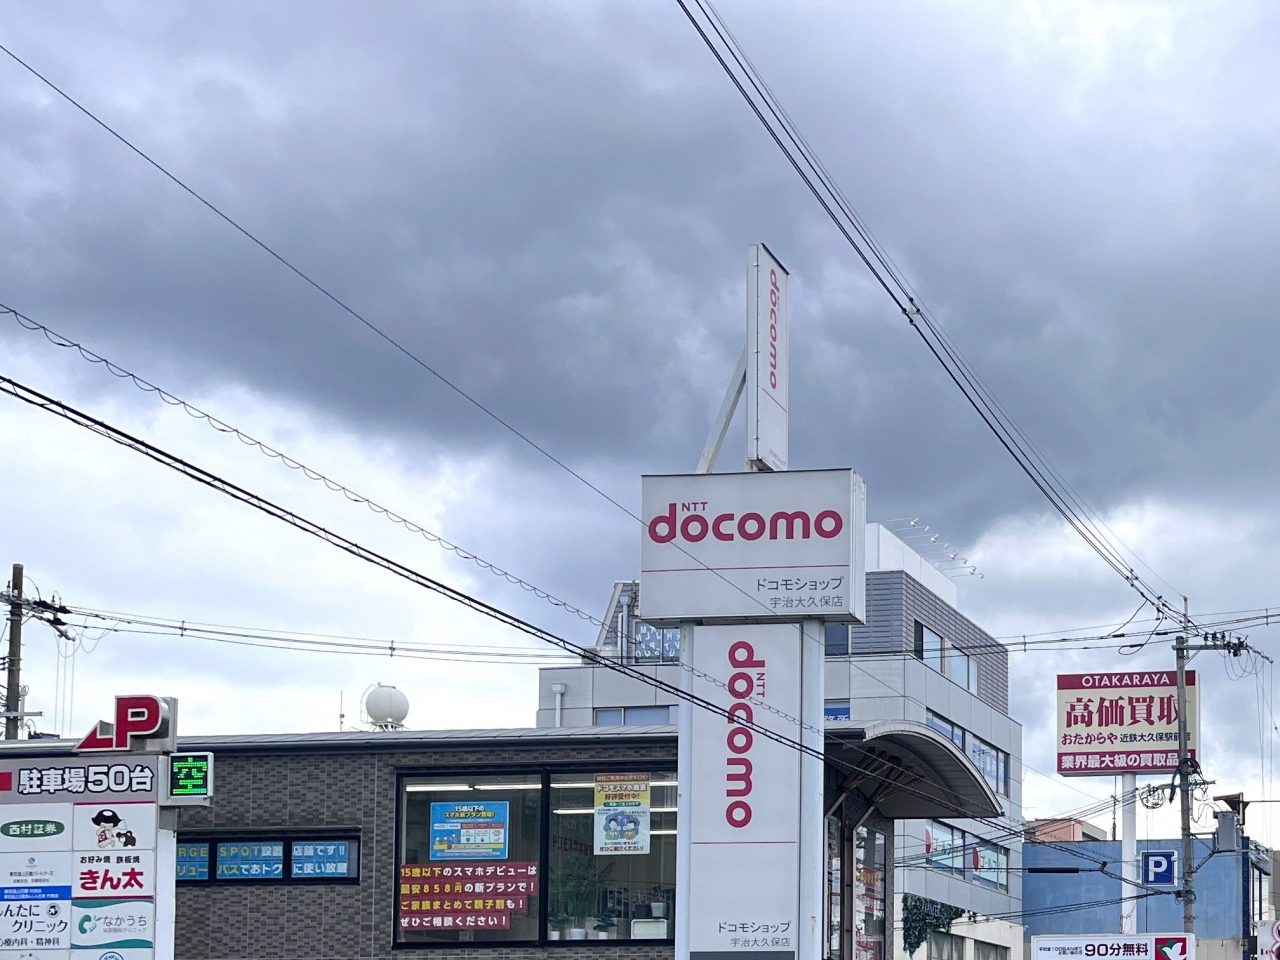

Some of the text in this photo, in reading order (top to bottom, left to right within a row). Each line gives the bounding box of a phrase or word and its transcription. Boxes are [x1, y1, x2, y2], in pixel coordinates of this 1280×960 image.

[768, 268, 781, 390] docomo
[681, 502, 708, 512] NTT
[648, 503, 843, 543] docomo
[756, 576, 844, 592] ドコモショップ
[769, 595, 843, 608] 宇治大久保店
[756, 672, 765, 698] NTT
[1081, 673, 1170, 687] OTAKARAYA
[116, 696, 161, 748] P
[725, 640, 765, 828] docomo
[1062, 732, 1118, 746] おたからや
[1062, 753, 1190, 769] 業界最大級の買取品
[18, 764, 154, 795] 駐車場50台
[1148, 856, 1168, 882] P
[80, 867, 144, 890] きん太
[12, 919, 68, 933] クリニック
[103, 915, 147, 927] なかうち
[717, 921, 791, 934] ドコモショップ
[730, 937, 791, 948] 宇治大久保店
[1085, 943, 1149, 957] 90分無料
